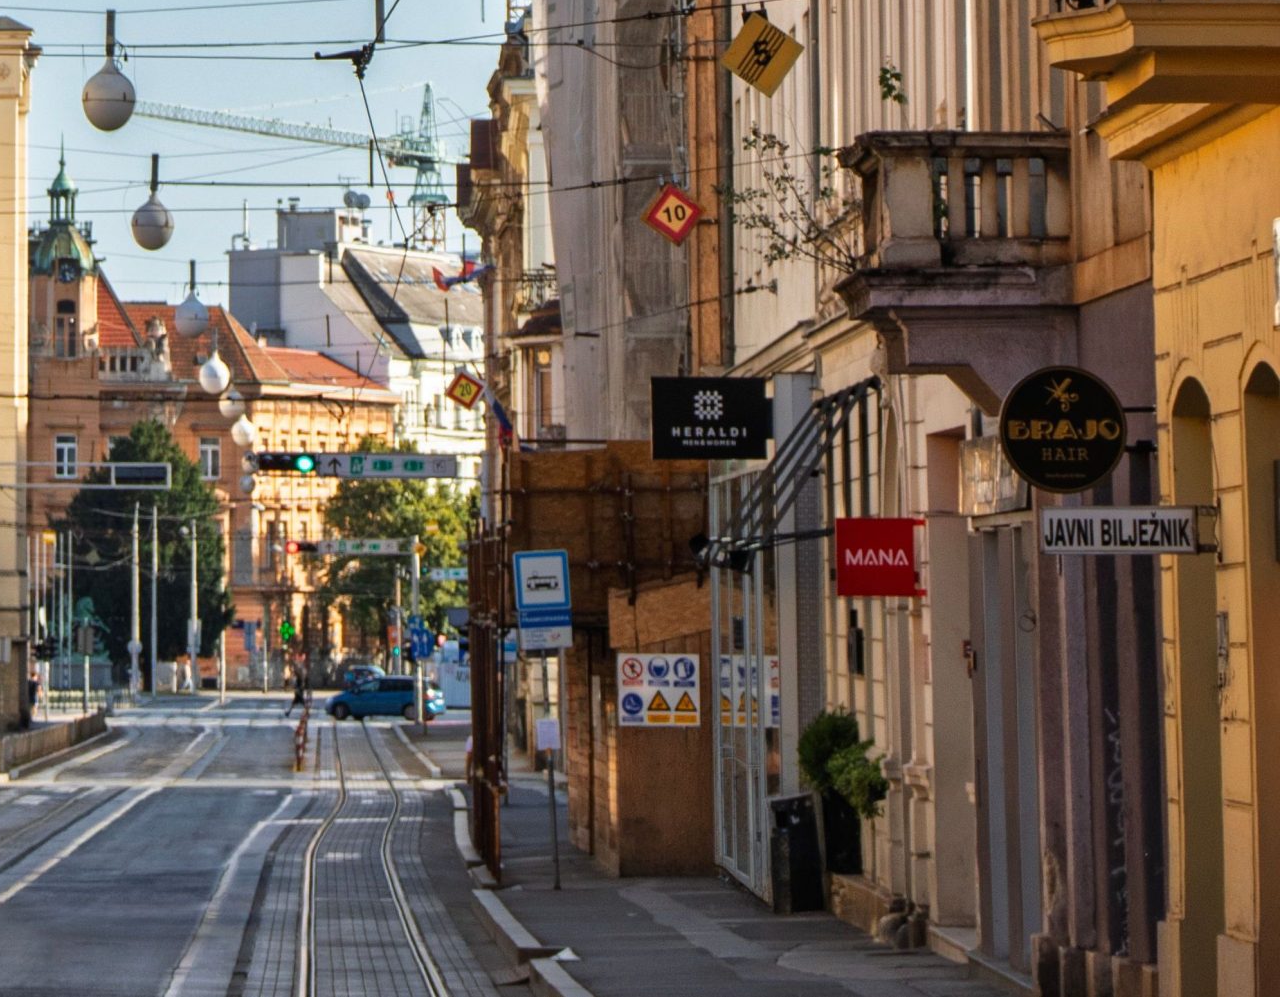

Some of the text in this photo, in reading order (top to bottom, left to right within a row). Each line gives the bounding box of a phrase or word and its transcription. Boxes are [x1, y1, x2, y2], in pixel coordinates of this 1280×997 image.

[662, 204, 686, 223] 10
[459, 383, 471, 396] 20
[671, 427, 747, 437] HERALDI
[1007, 419, 1120, 440] BRAJO
[1041, 447, 1089, 461] HAIR
[1044, 511, 1191, 547] JAVNI BILJEŽNIK
[845, 548, 909, 566] MANA
